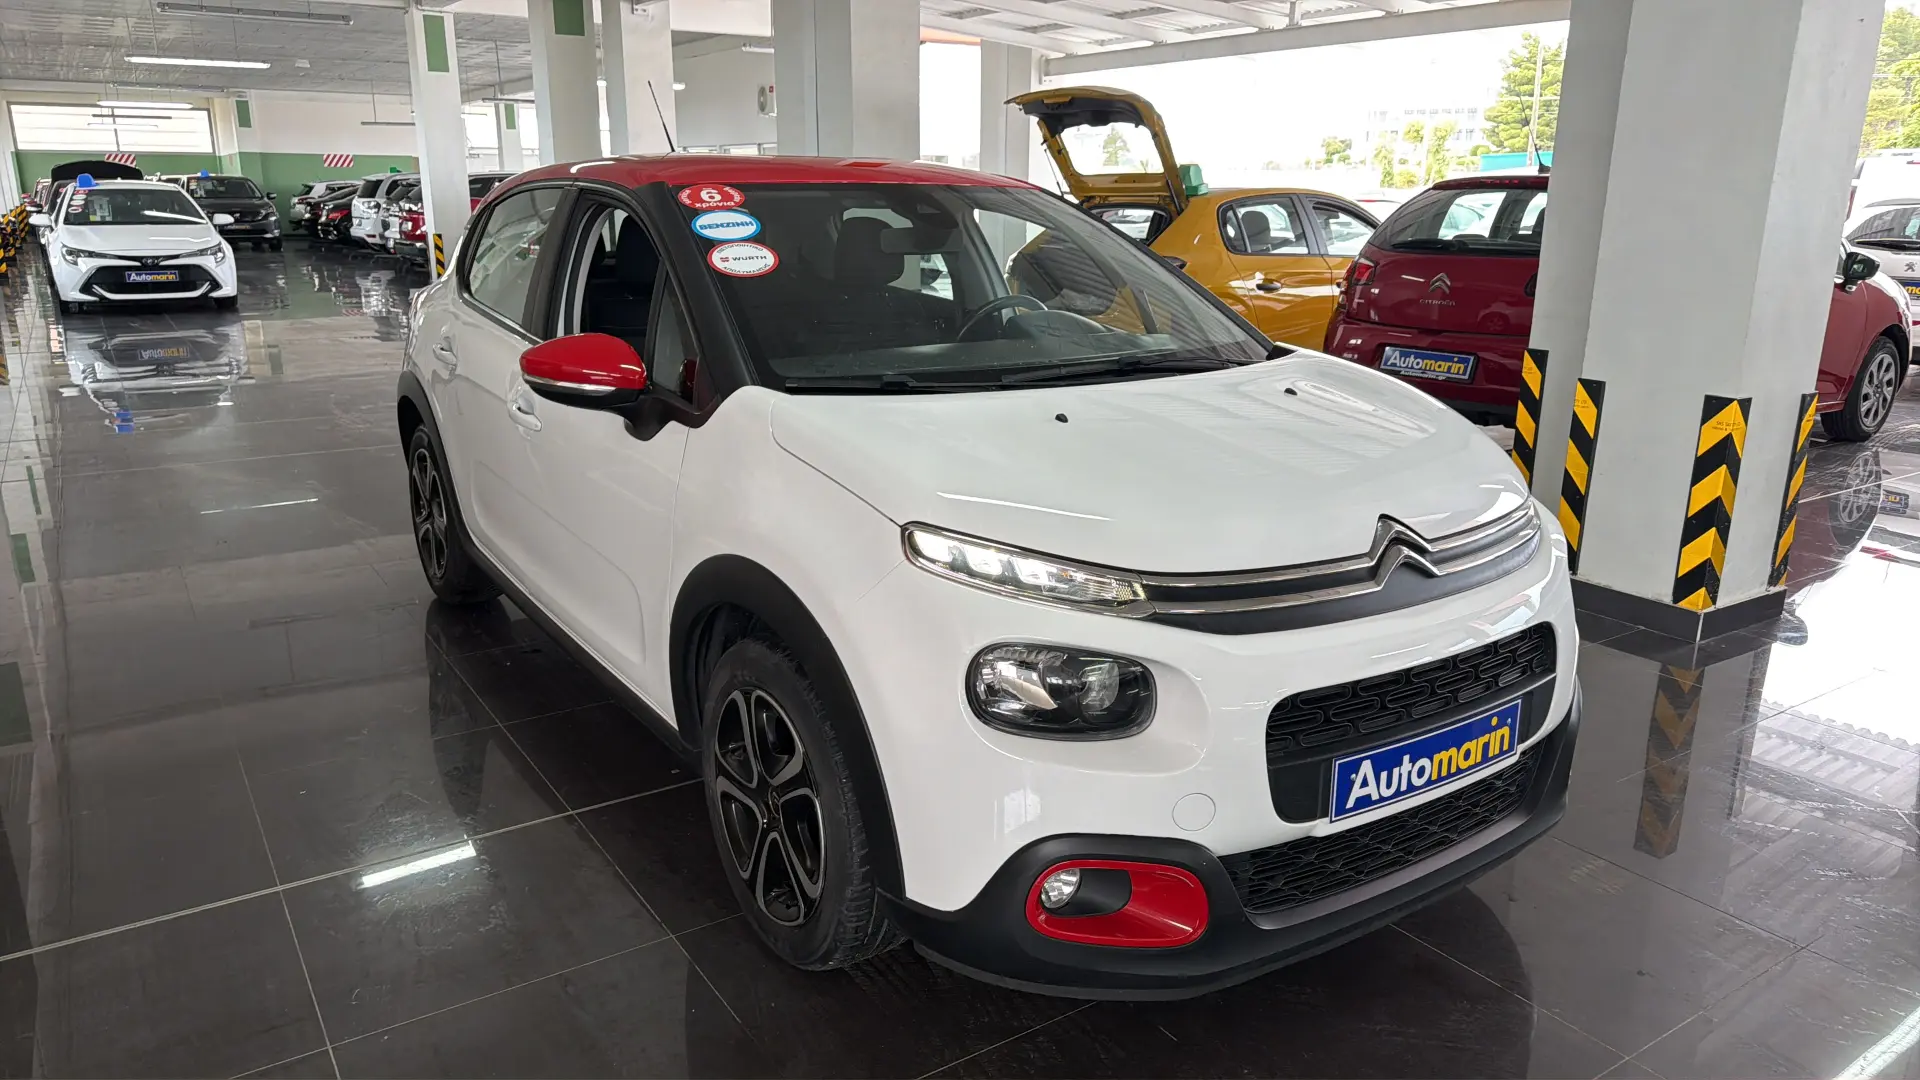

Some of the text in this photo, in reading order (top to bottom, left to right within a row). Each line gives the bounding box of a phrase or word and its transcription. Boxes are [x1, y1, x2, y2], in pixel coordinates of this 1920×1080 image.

[700, 189, 722, 202] 6
[130, 272, 176, 281] Automarin
[1386, 350, 1465, 375] Automarin
[1345, 716, 1512, 809] Automarin
